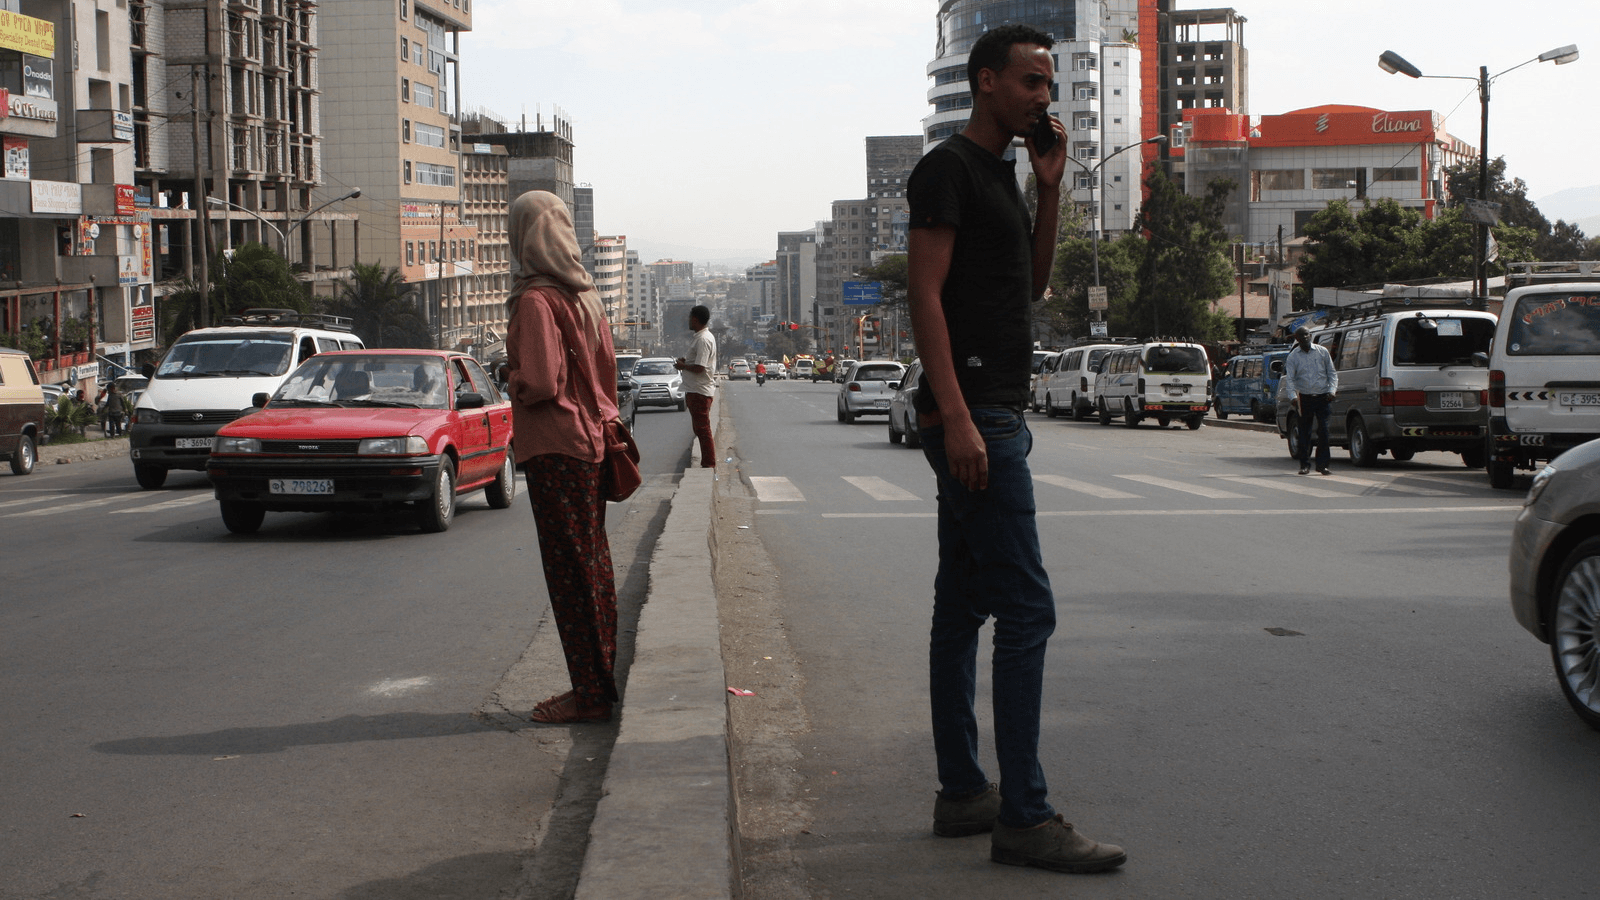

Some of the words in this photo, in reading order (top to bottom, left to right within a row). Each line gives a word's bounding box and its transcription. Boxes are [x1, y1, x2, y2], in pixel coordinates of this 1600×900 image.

[1372, 112, 1422, 133] Eliana
[1441, 400, 1462, 408] 52564
[191, 438, 211, 447] 36949
[291, 480, 326, 492] 79826
